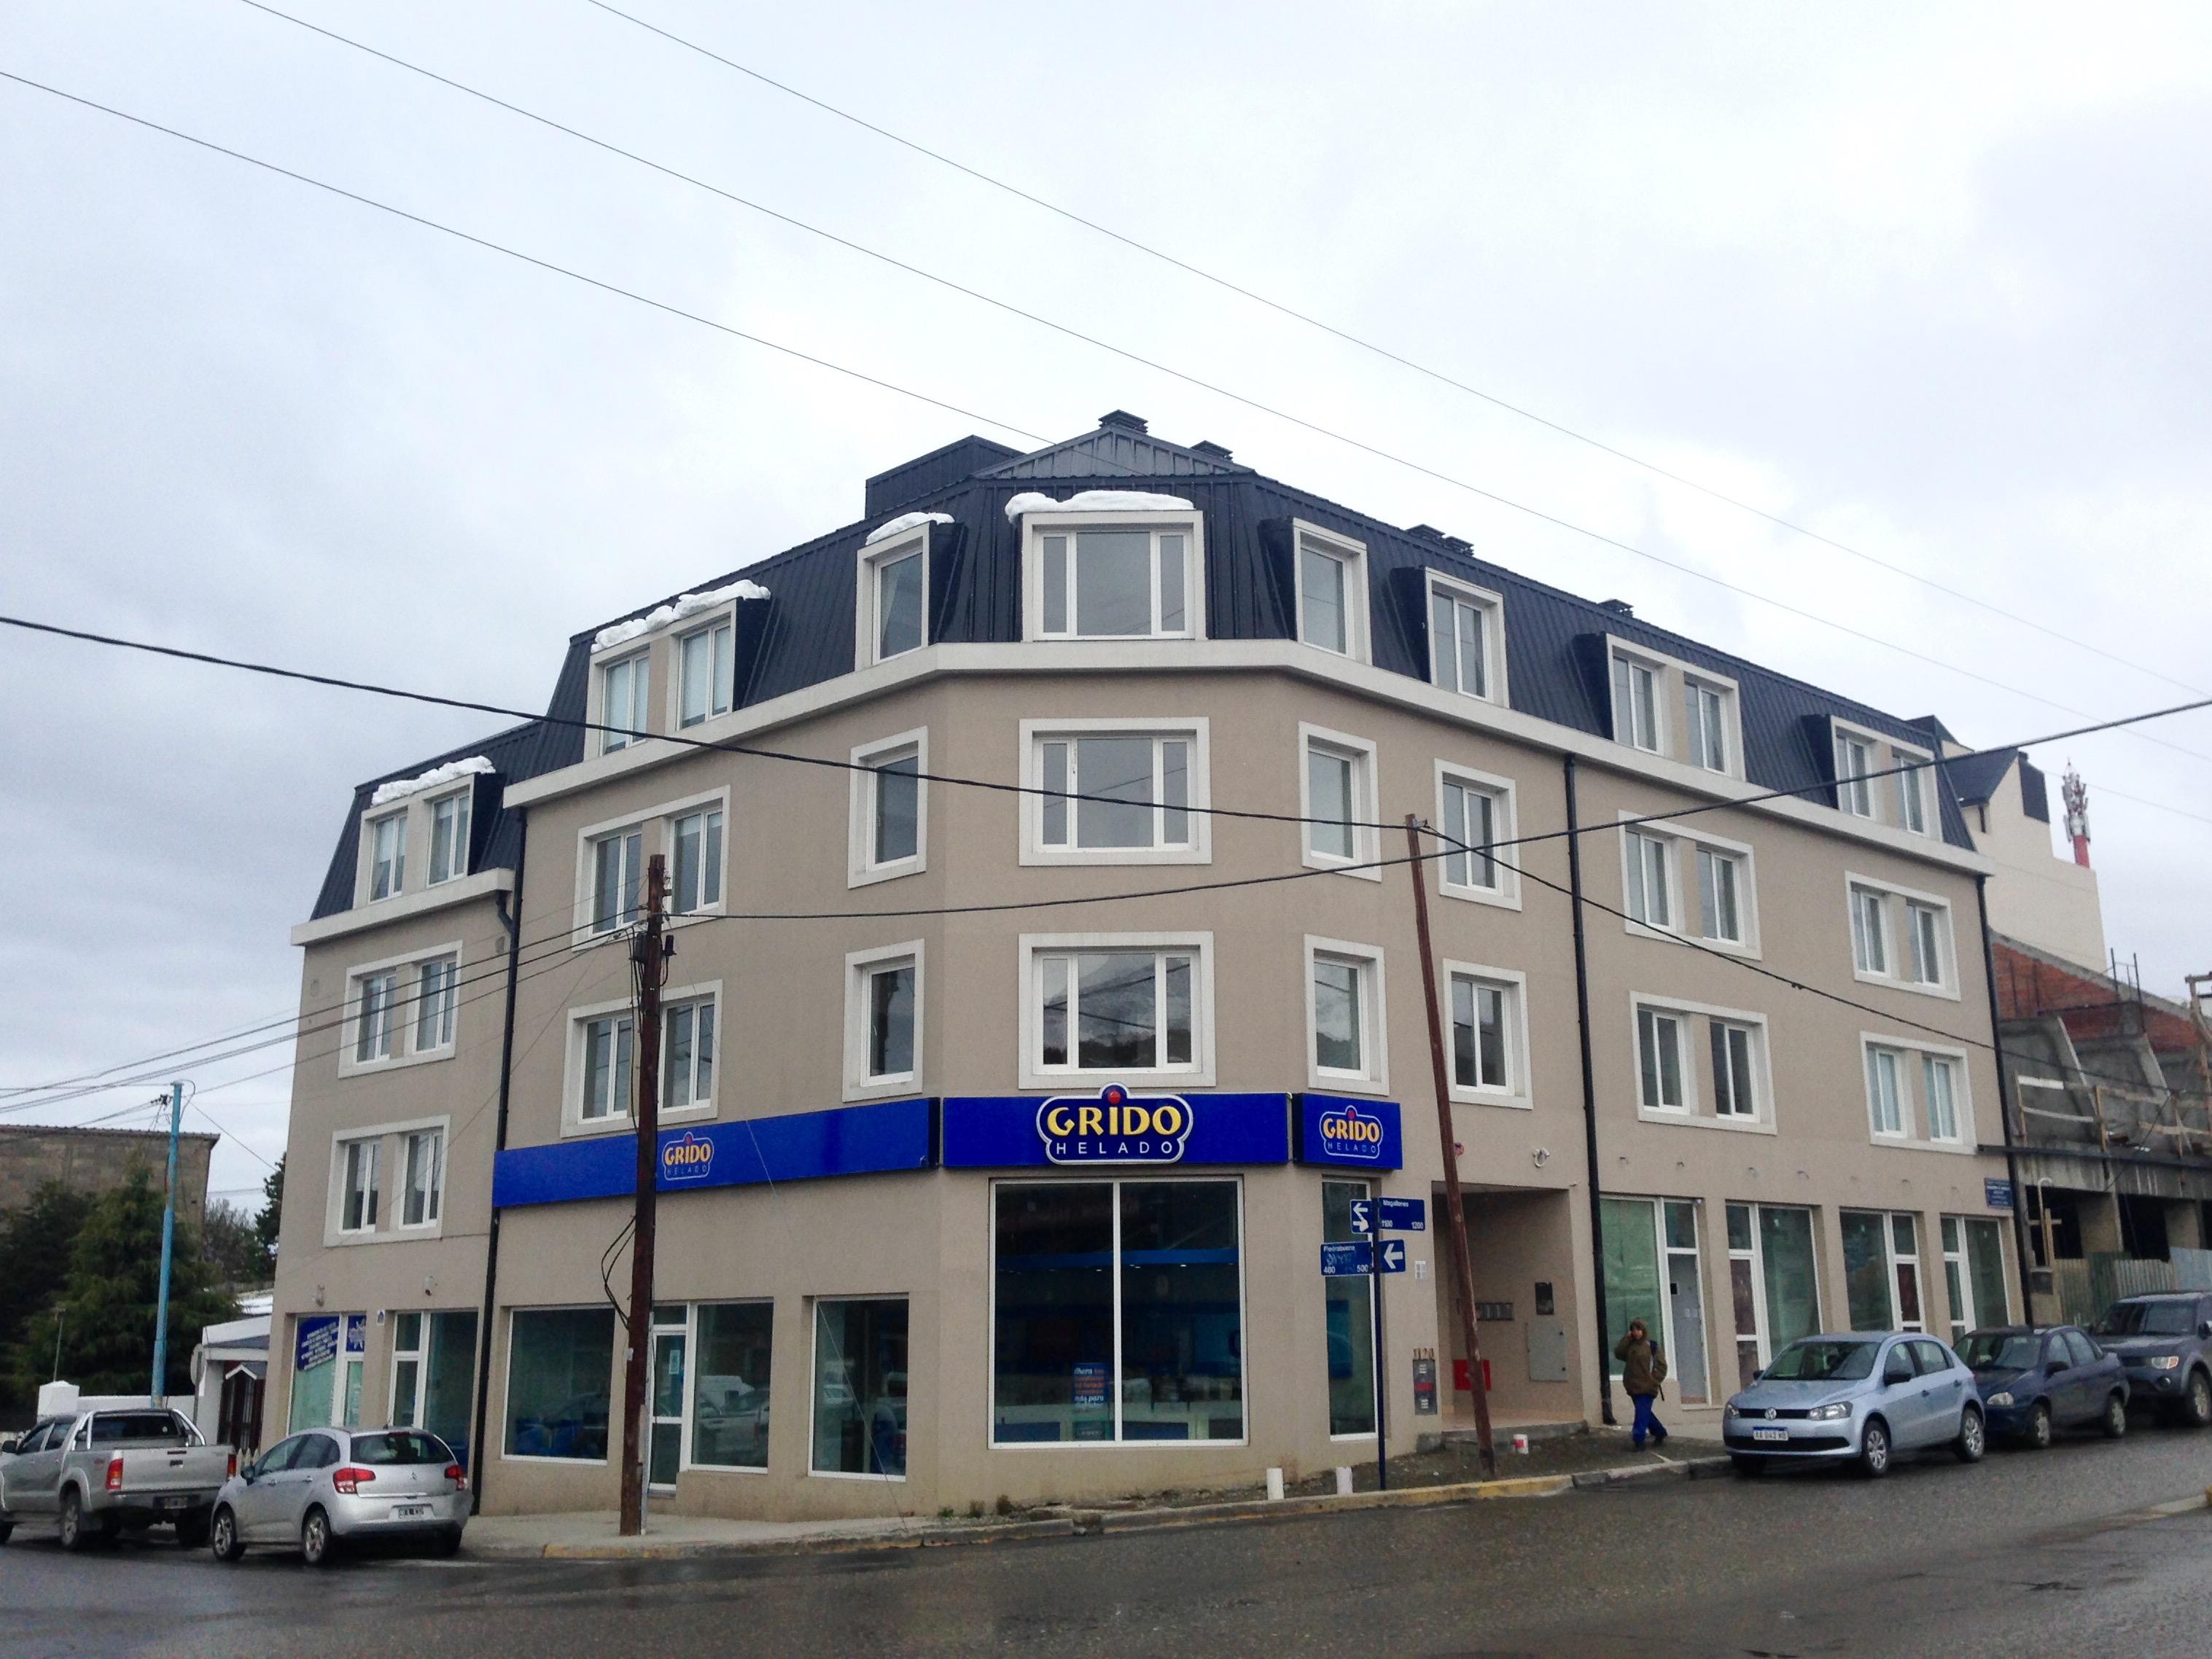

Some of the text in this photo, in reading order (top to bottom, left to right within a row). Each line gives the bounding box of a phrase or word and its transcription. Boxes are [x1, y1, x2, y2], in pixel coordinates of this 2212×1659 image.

[1047, 1106, 1182, 1136] GRIDO
[1323, 1118, 1379, 1142] GRIDO
[1056, 1141, 1172, 1154] HELADO
[1328, 1142, 1376, 1153] HELADO
[665, 1143, 711, 1166] GRIDO
[1411, 1221, 1423, 1229] 1200
[1357, 1264, 1368, 1273] 500
